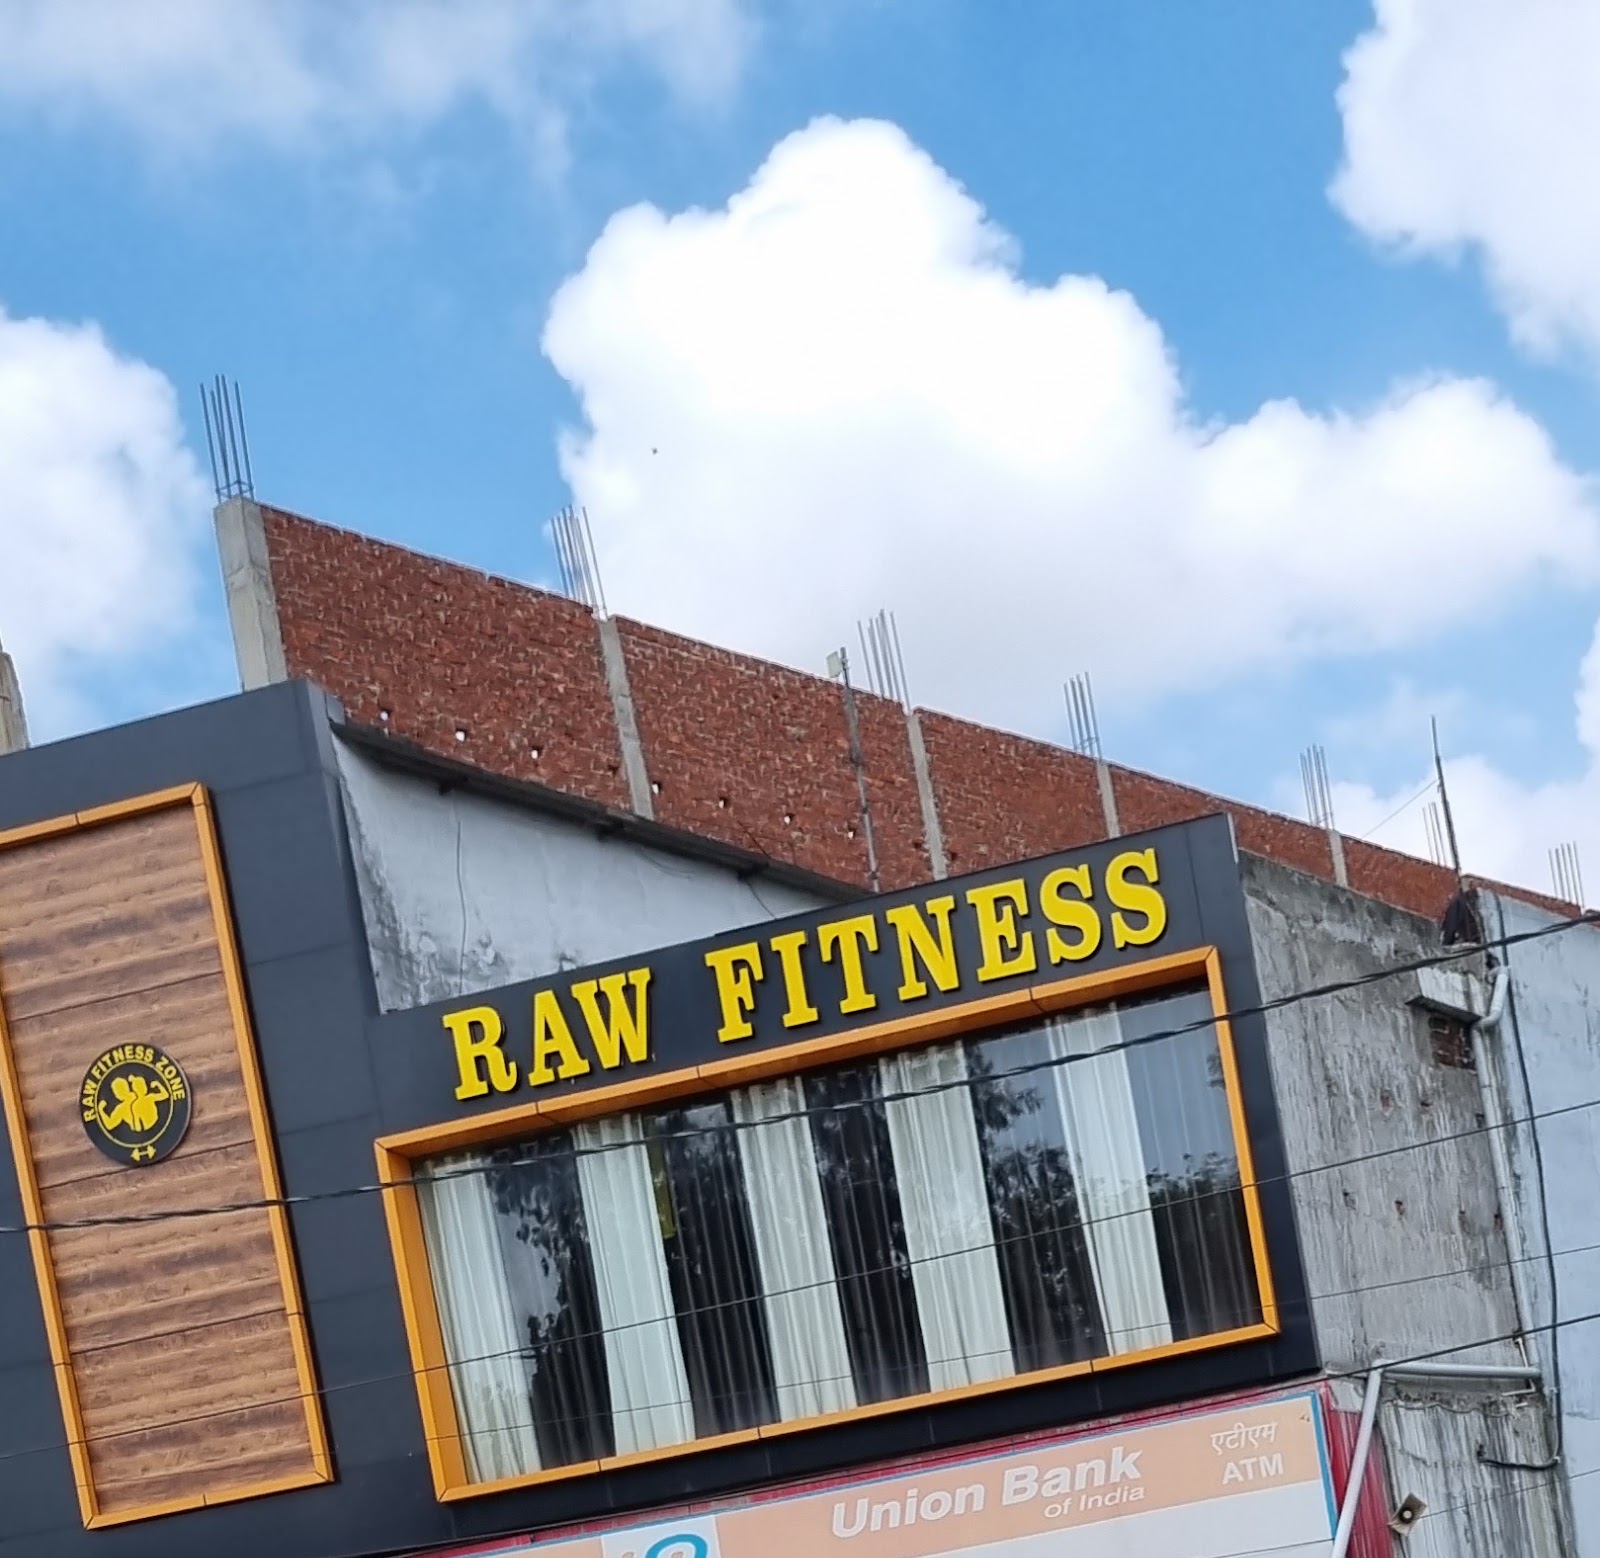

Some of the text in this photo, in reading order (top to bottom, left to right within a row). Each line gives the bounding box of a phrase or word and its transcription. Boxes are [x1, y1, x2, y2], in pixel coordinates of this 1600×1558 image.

[444, 848, 1167, 1099] RAW FITNESS
[82, 1045, 185, 1122] RAW FITNESS ZONE
[1210, 1422, 1279, 1455] एटीएम
[832, 1446, 1143, 1538] Union Bank
[1222, 1453, 1284, 1485] ATM
[1044, 1485, 1145, 1519] of India
